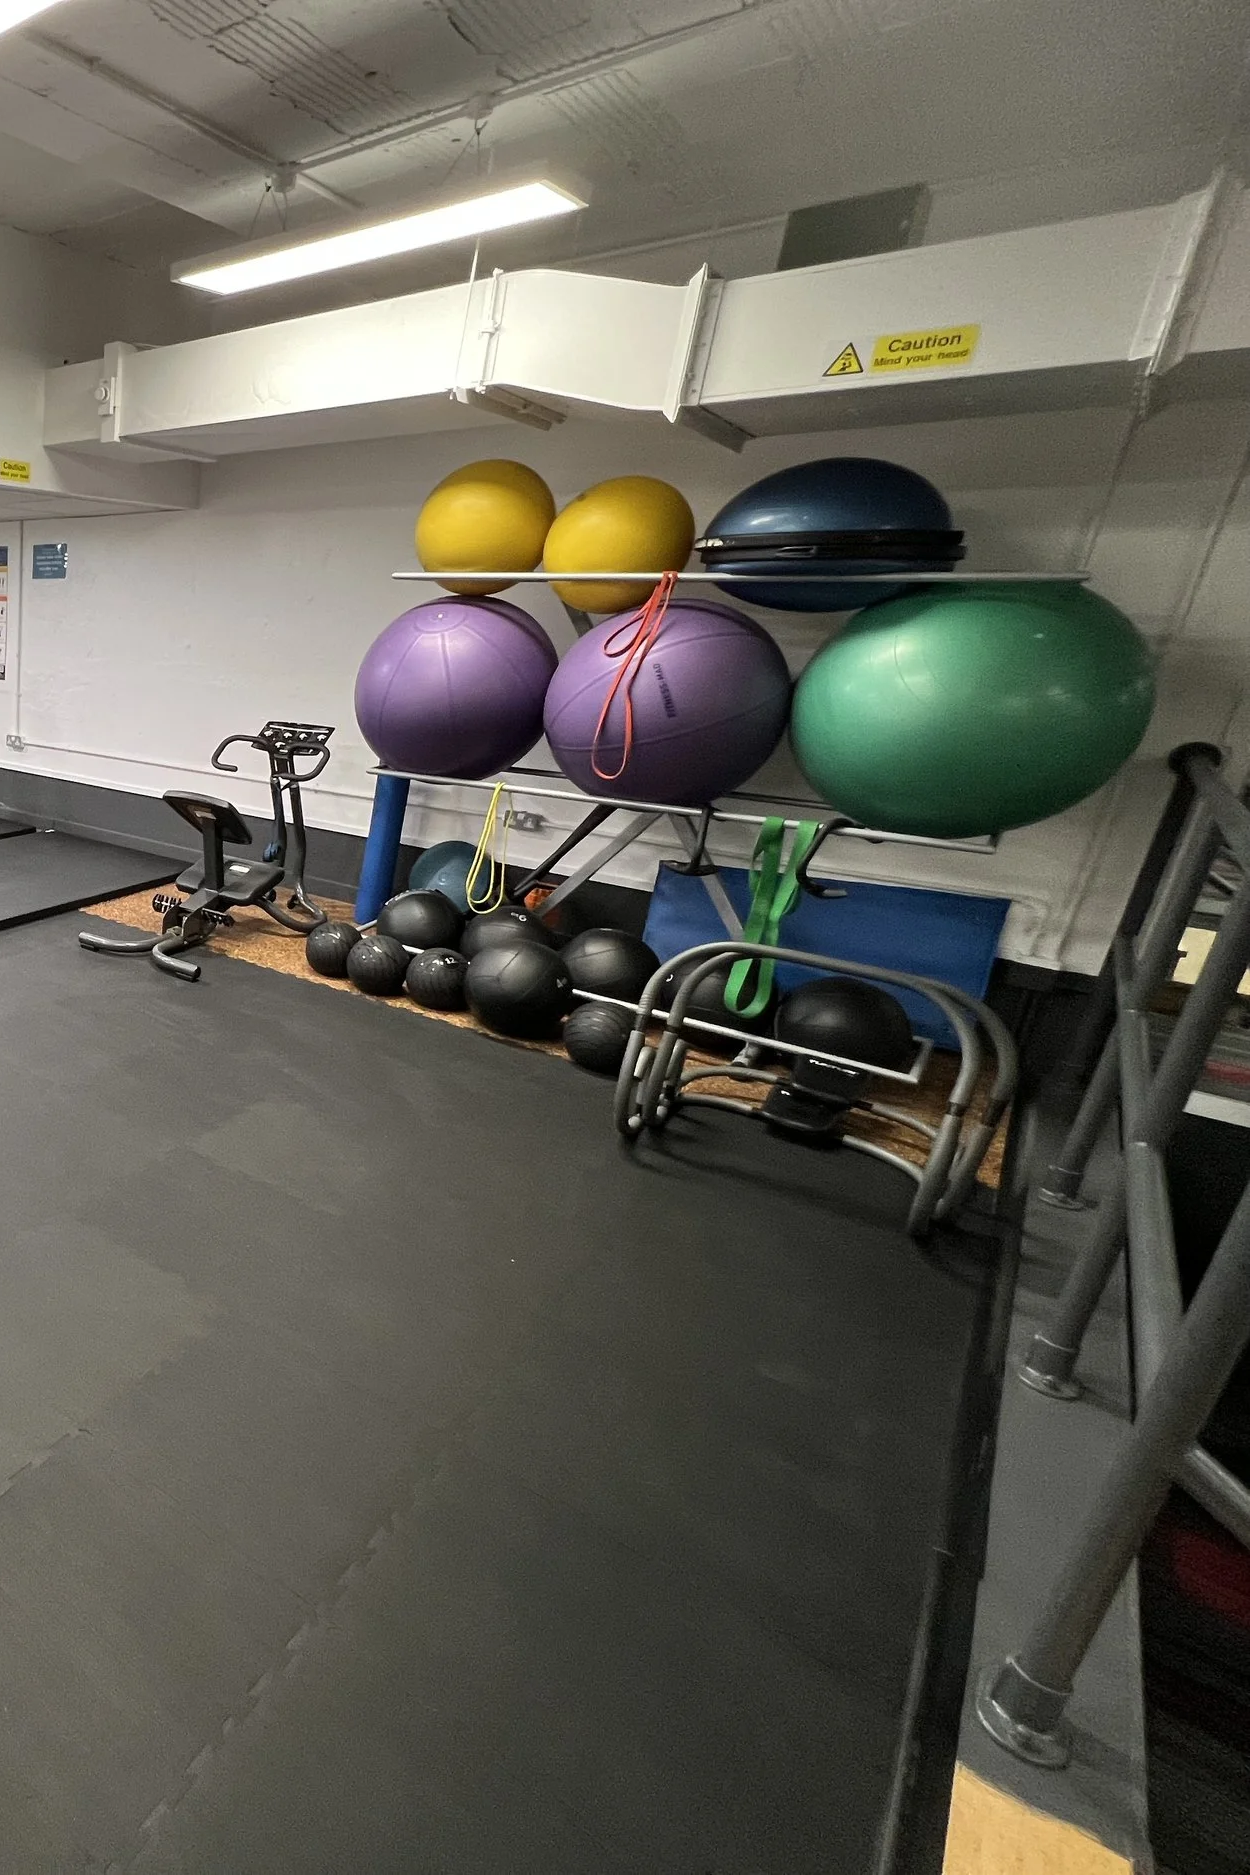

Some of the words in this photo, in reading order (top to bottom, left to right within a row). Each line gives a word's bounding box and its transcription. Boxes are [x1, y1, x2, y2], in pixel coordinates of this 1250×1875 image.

[888, 334, 962, 353] Caution
[873, 355, 902, 367] Mind
[905, 354, 932, 366] your
[937, 348, 970, 360] head
